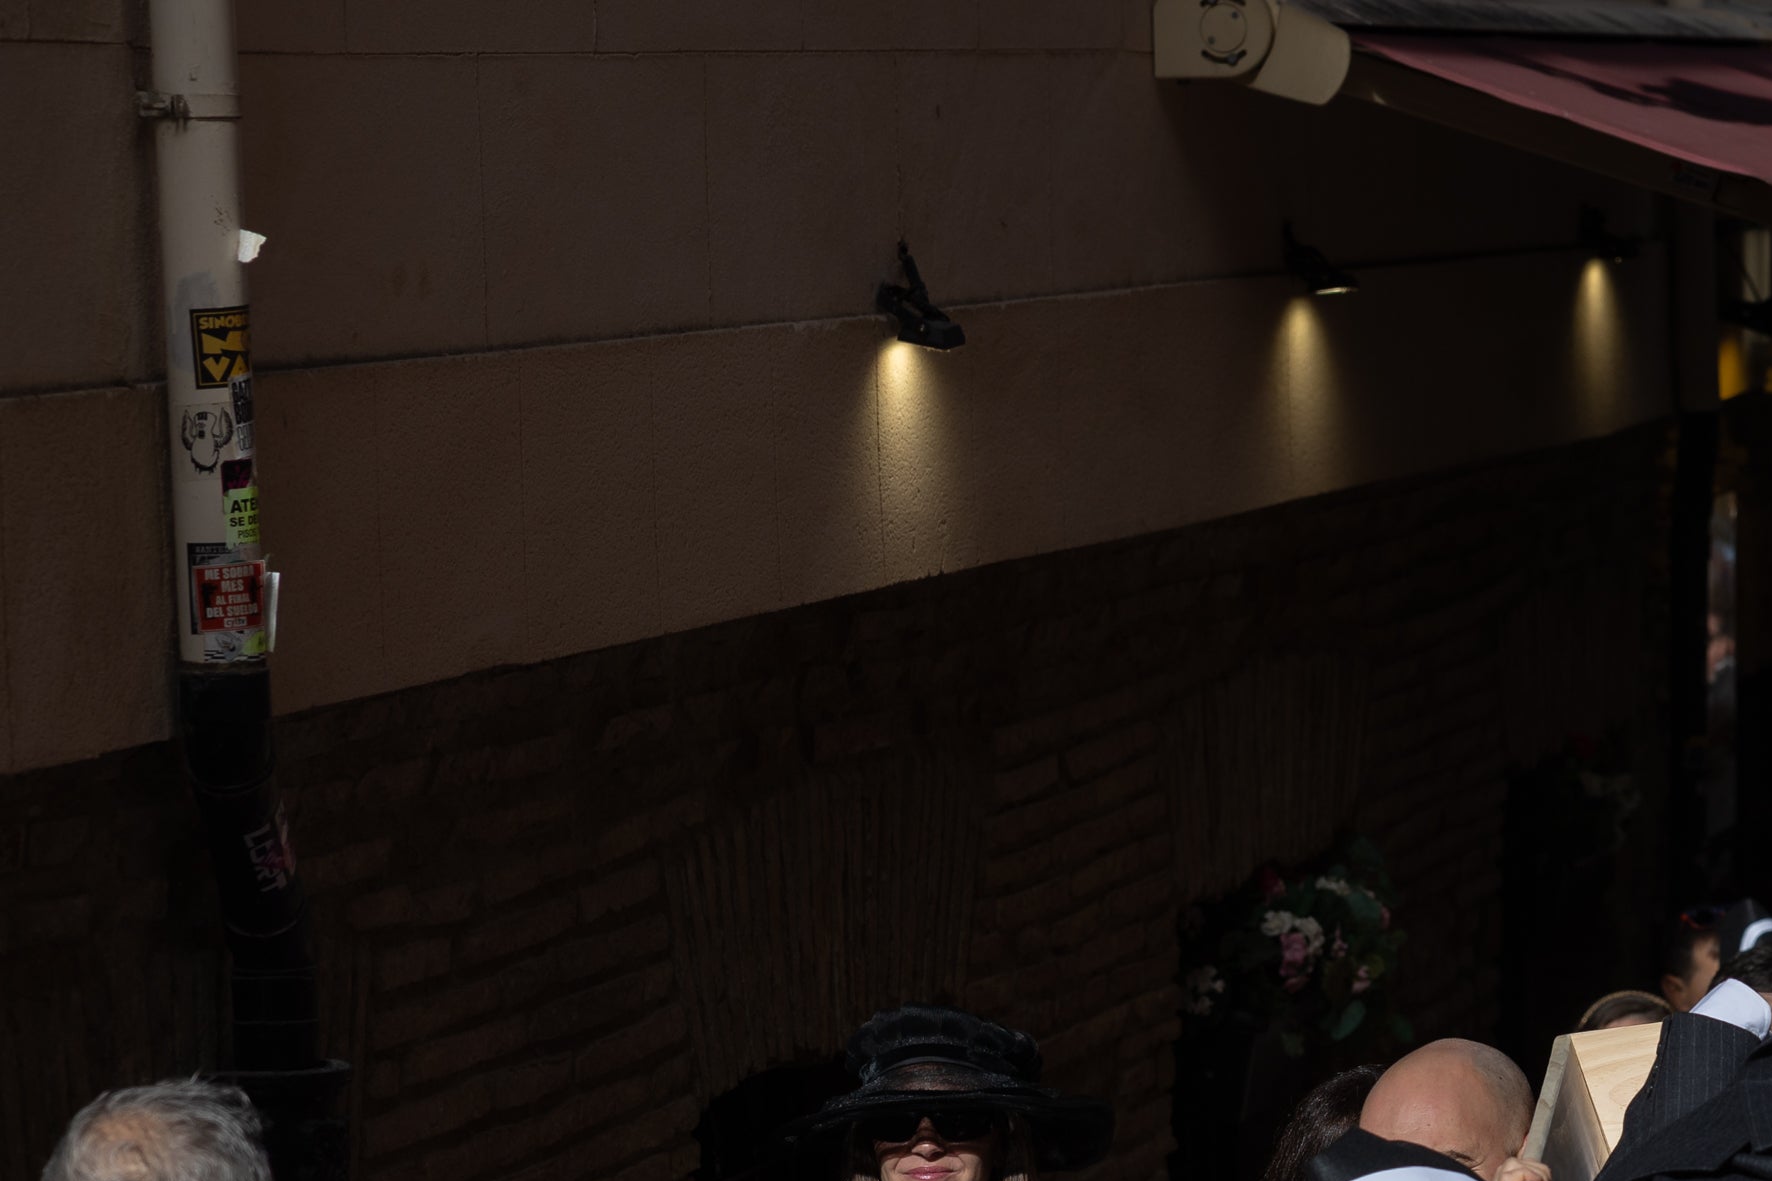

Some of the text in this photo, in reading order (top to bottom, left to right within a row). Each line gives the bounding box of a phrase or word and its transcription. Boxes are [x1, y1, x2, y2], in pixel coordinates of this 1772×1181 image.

[221, 579, 244, 592] MES
[216, 595, 226, 606] AL
[206, 606, 224, 618] DEL
